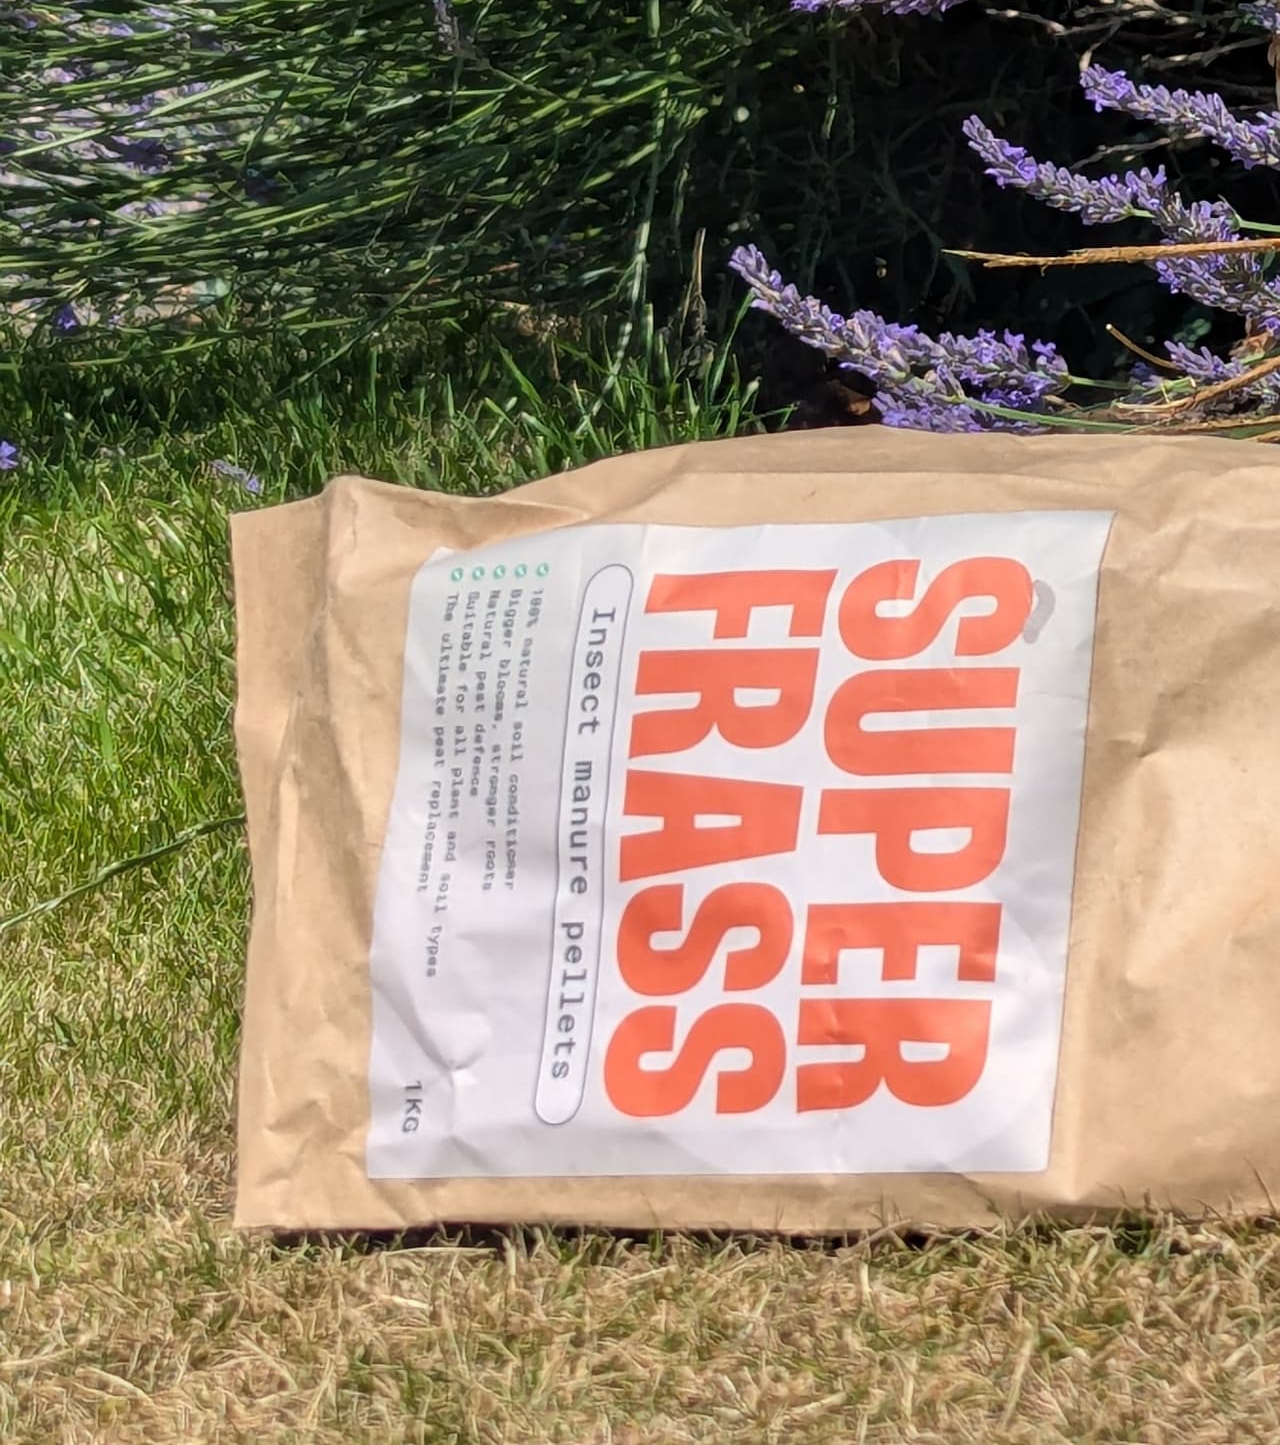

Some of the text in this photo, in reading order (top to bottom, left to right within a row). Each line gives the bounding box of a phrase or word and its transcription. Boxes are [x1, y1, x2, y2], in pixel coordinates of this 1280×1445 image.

[417, 592, 459, 893] The ultimate peat replacement
[426, 591, 480, 978] Suitable for all plant and soil types
[469, 589, 501, 797] Natural pest defence
[482, 589, 523, 890] Bigger blooms, stronger roots
[504, 588, 544, 890] 100% natural soil conditioner
[551, 607, 616, 1079] Insect manure pellets
[604, 568, 837, 1117] FRASS
[796, 556, 1034, 1114] SUPER
[401, 1080, 423, 1134] 1KG
